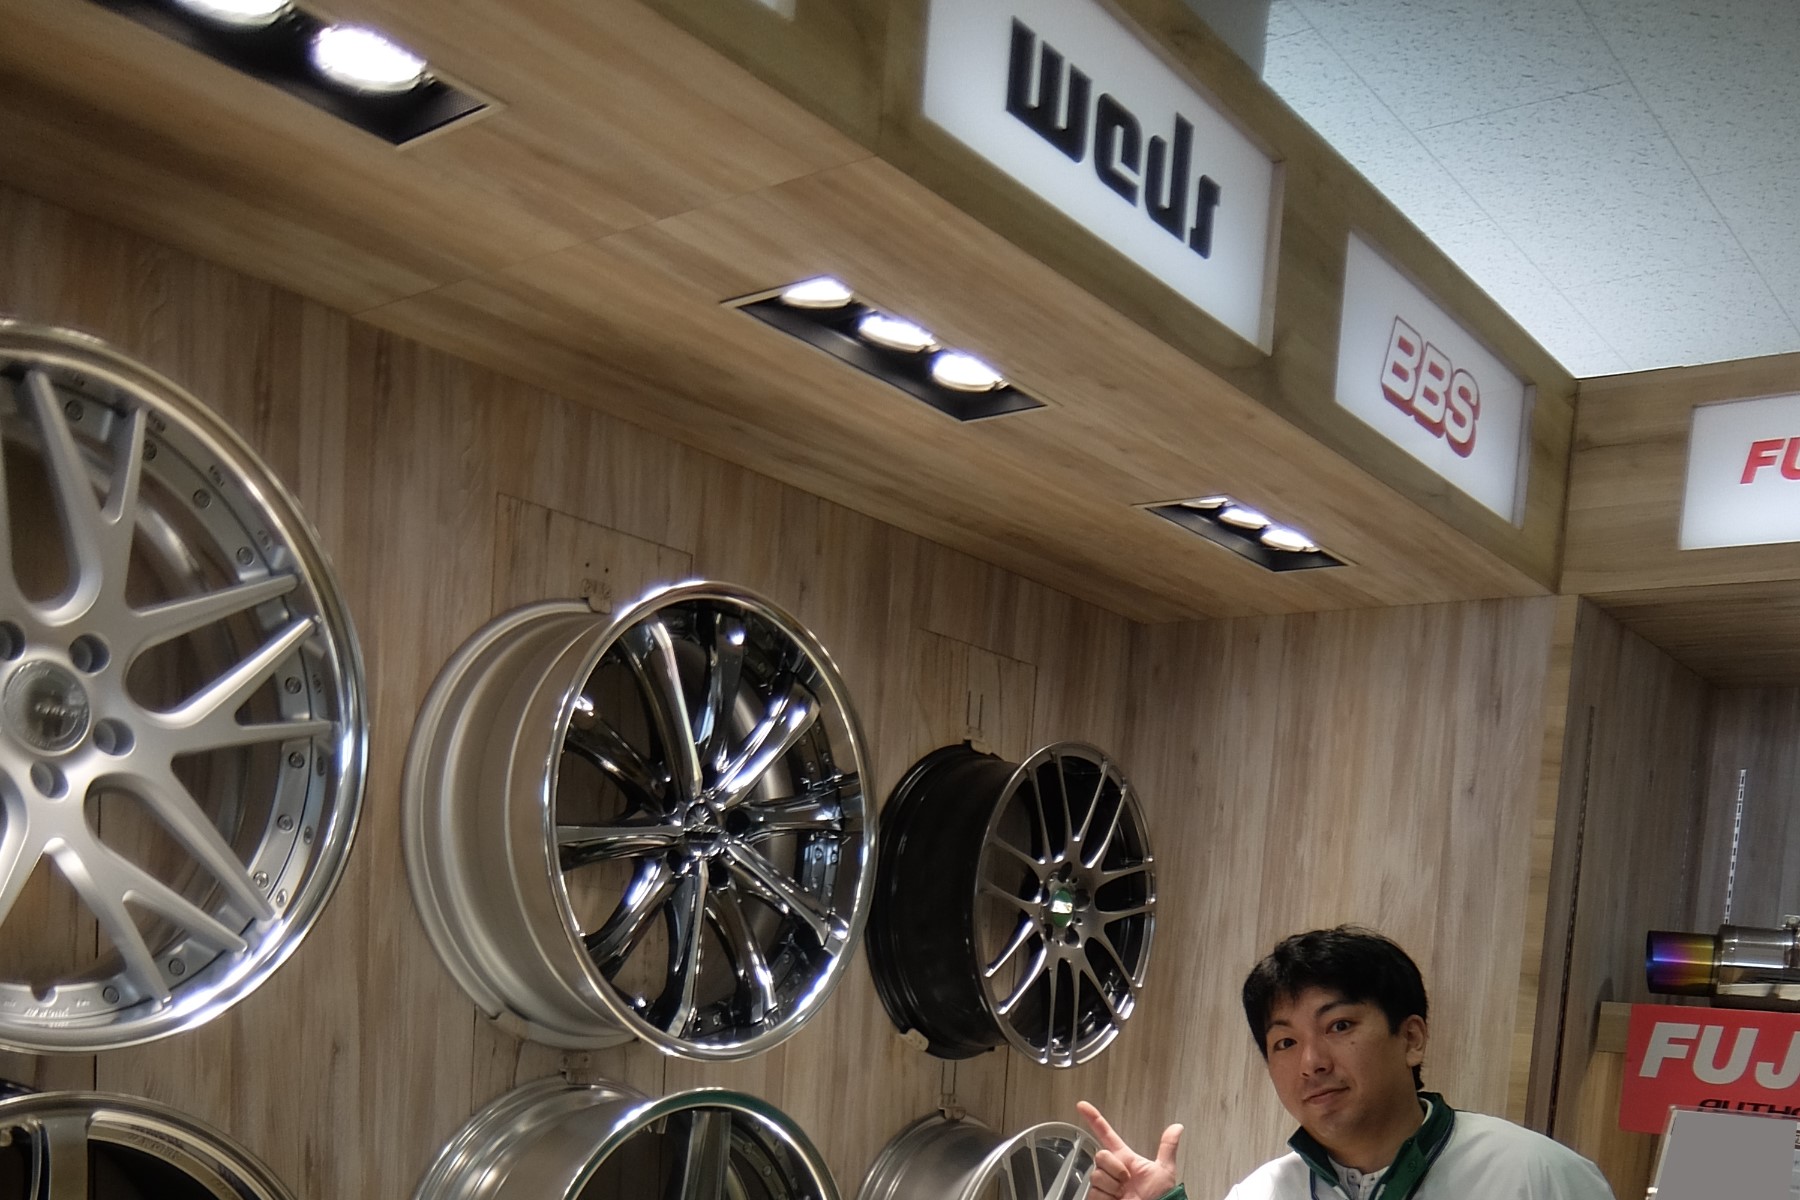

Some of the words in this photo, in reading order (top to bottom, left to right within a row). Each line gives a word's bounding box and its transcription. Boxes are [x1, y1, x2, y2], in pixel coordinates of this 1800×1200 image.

[1005, 15, 1221, 259] weds
[1381, 316, 1481, 458] BBS
[1639, 1021, 1800, 1090] FUJ
